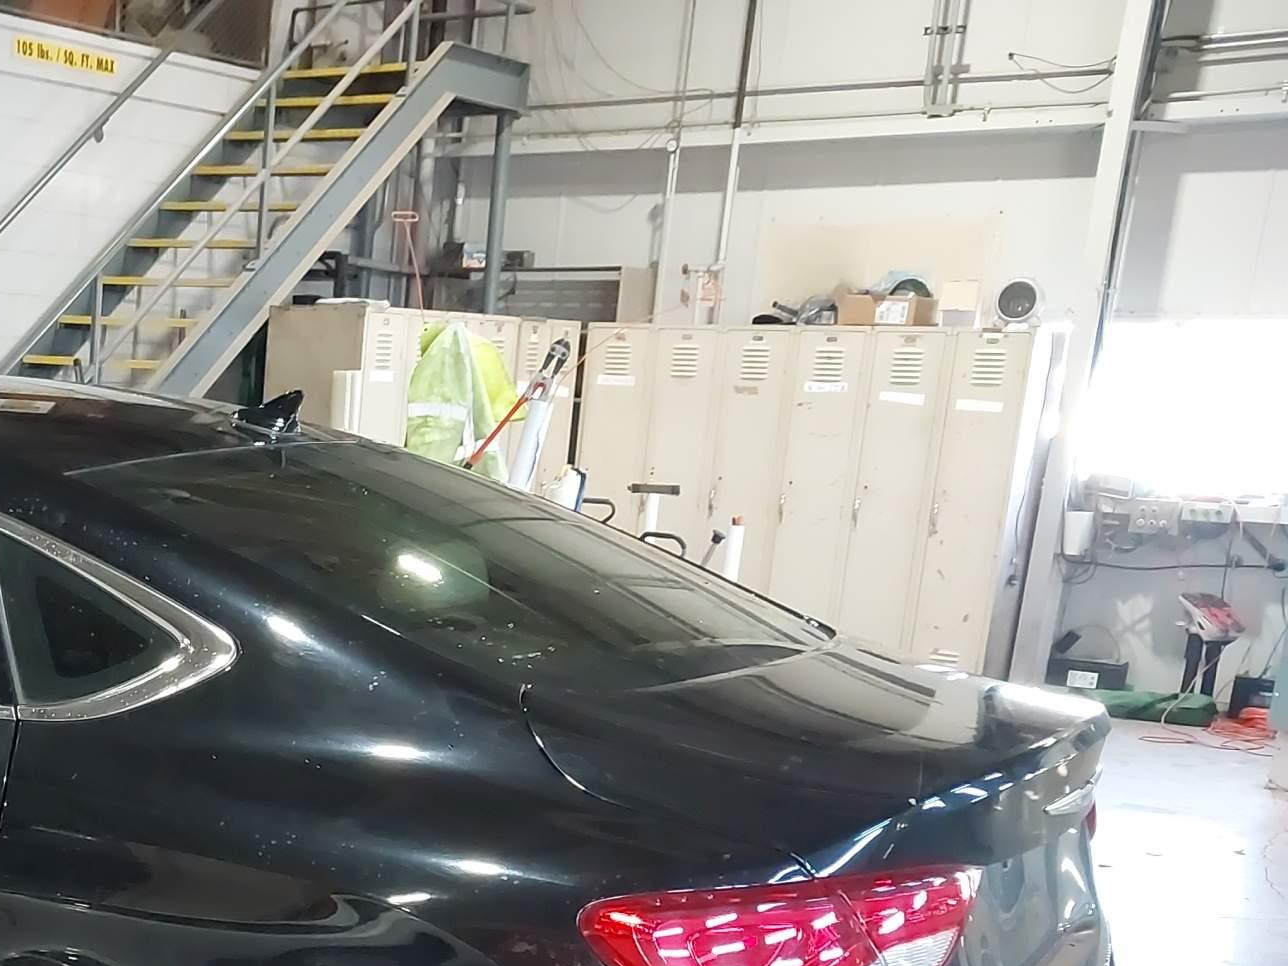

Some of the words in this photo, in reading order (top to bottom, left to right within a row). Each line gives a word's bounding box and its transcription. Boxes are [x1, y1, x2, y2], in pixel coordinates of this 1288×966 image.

[17, 39, 33, 57] 105
[37, 42, 53, 61] lbs.
[64, 49, 78, 67] SQ.
[81, 53, 93, 70] FT.
[96, 56, 115, 74] MAX
